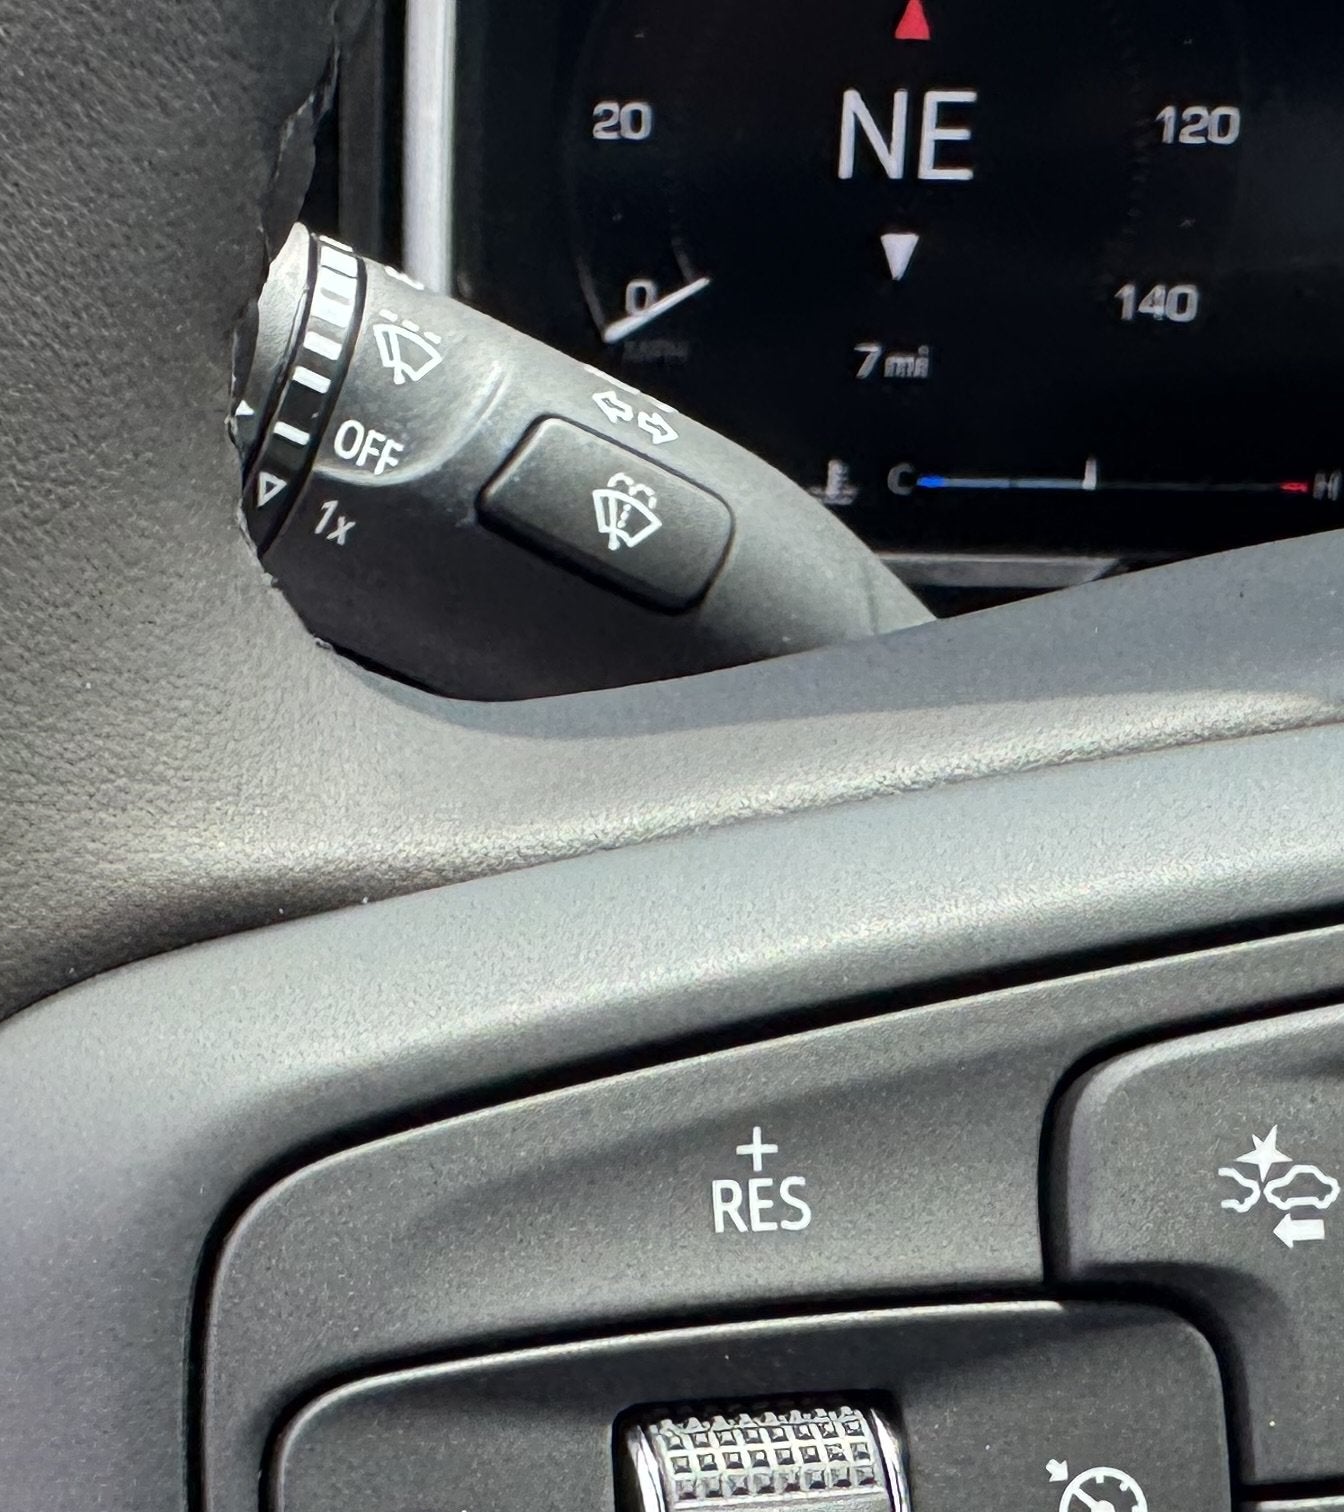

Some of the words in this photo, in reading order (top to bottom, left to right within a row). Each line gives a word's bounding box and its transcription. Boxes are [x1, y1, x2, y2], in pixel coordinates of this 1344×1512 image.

[592, 100, 652, 141] 20
[838, 88, 979, 181] NE
[1155, 105, 1241, 146] 120
[625, 279, 657, 319] 0
[1115, 283, 1200, 324] 140
[854, 343, 882, 379] 7
[883, 344, 930, 379] mi
[333, 419, 404, 476] OFF
[887, 462, 914, 496] C
[314, 500, 356, 546] 1x
[711, 1175, 812, 1233] RES
